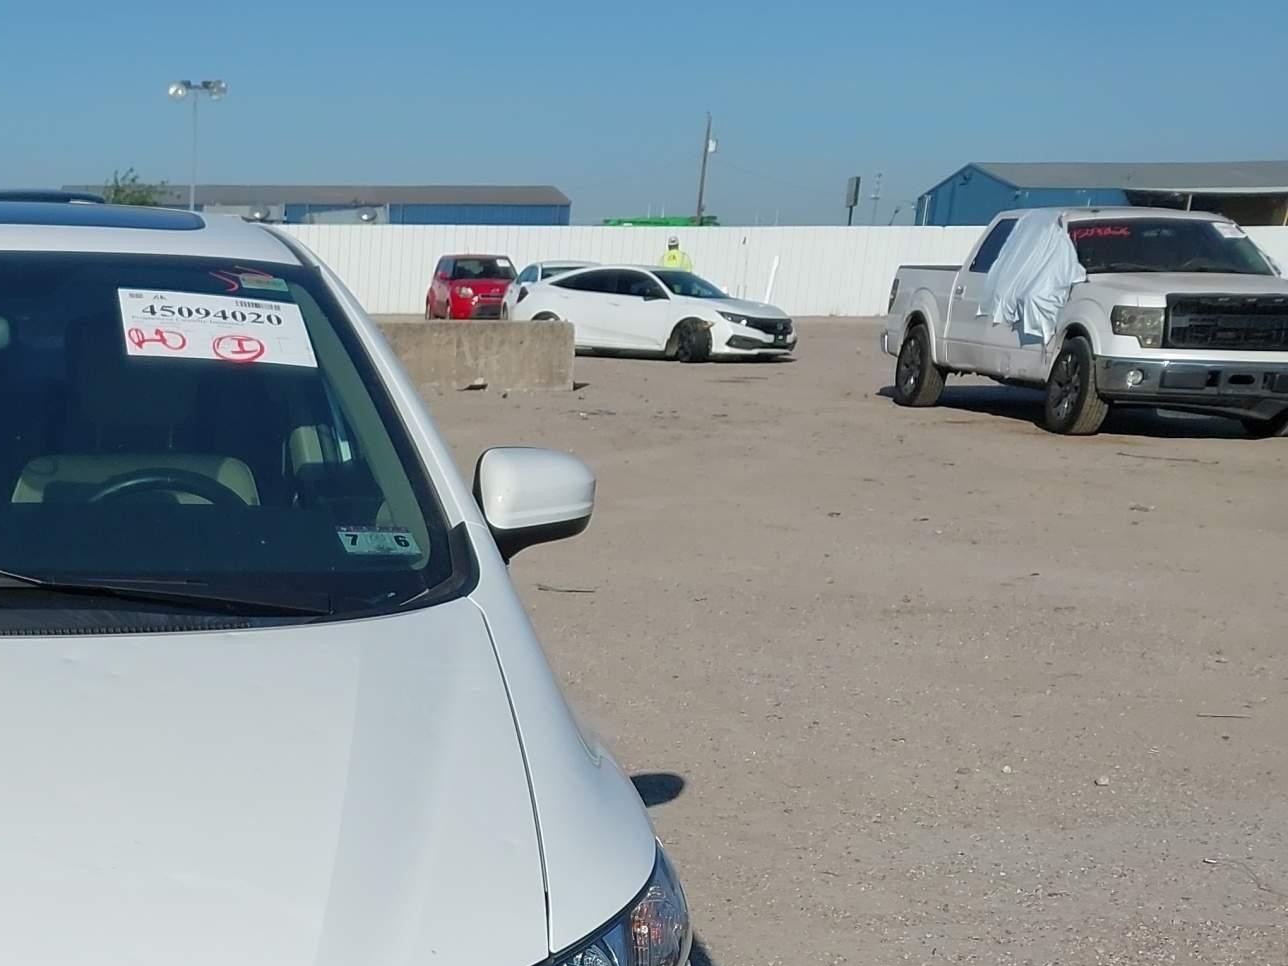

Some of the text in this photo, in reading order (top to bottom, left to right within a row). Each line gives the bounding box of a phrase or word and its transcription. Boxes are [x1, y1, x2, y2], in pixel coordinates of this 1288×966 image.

[141, 304, 283, 326] 45094020
[344, 533, 410, 548] 7 6
